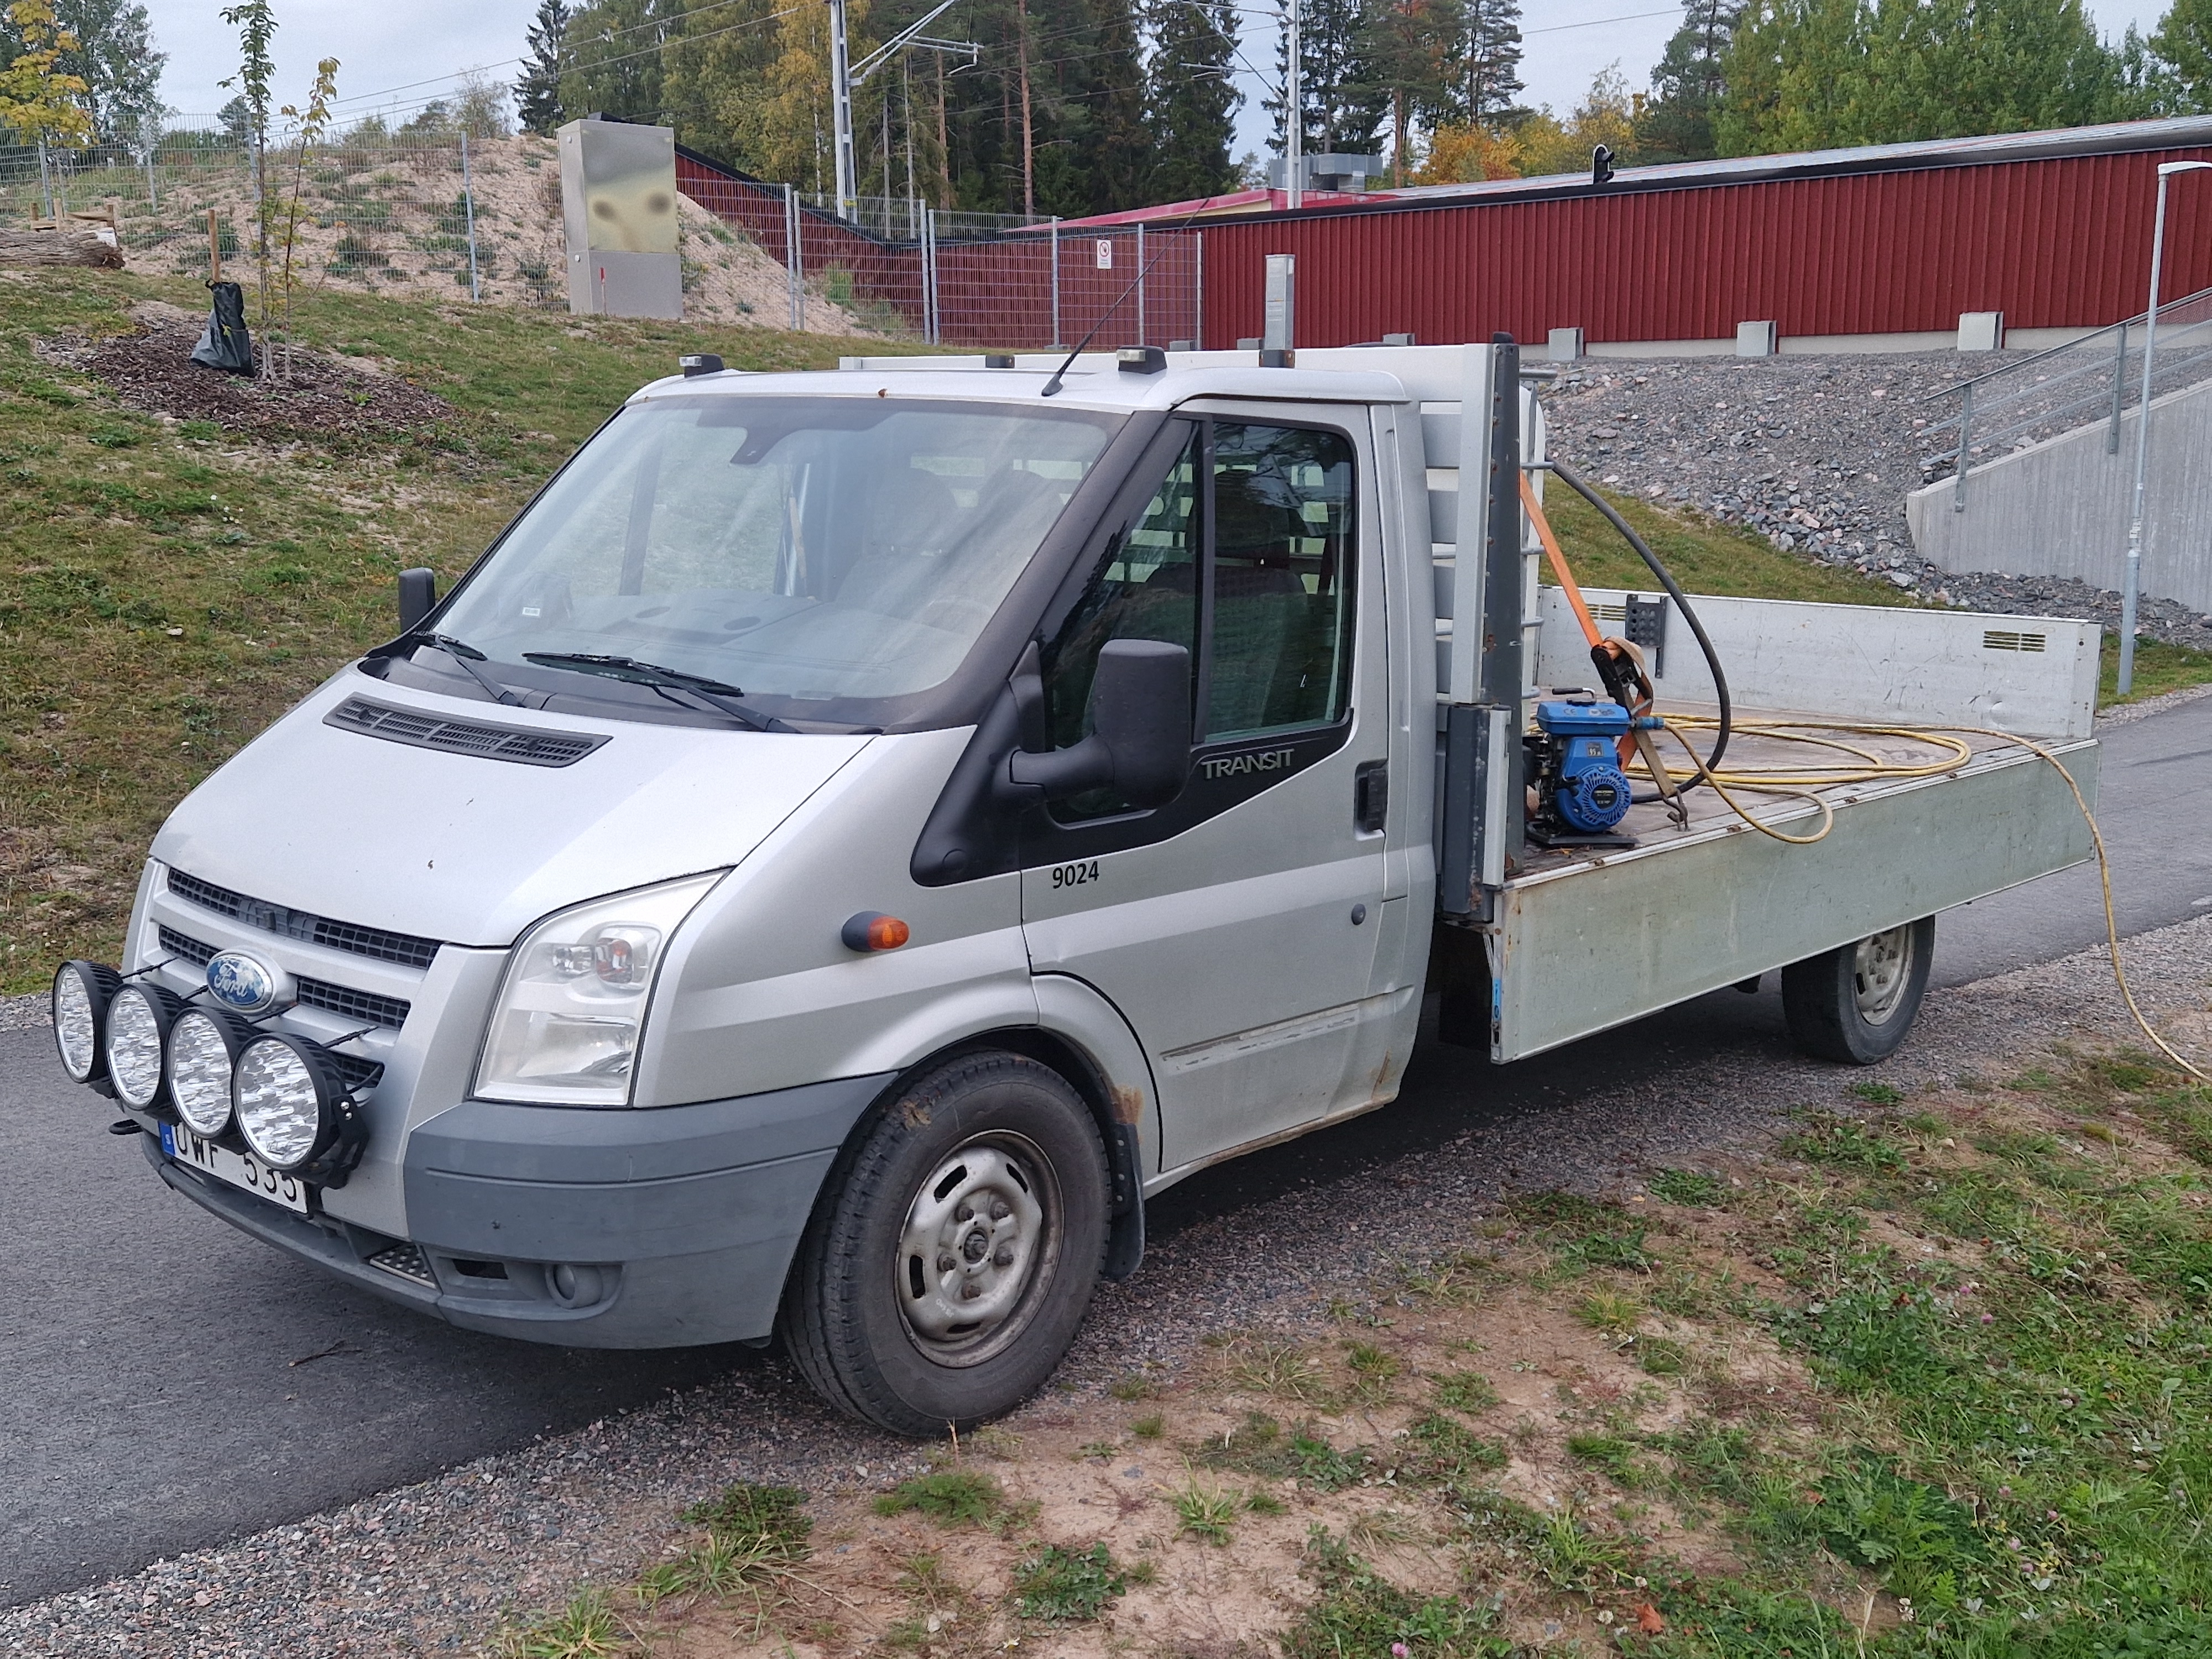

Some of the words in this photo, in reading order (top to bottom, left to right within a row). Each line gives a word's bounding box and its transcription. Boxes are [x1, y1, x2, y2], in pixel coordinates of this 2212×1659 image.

[1201, 748, 1295, 779] TRANSIT
[1052, 860, 1099, 889] 9024
[214, 963, 250, 998] Ford
